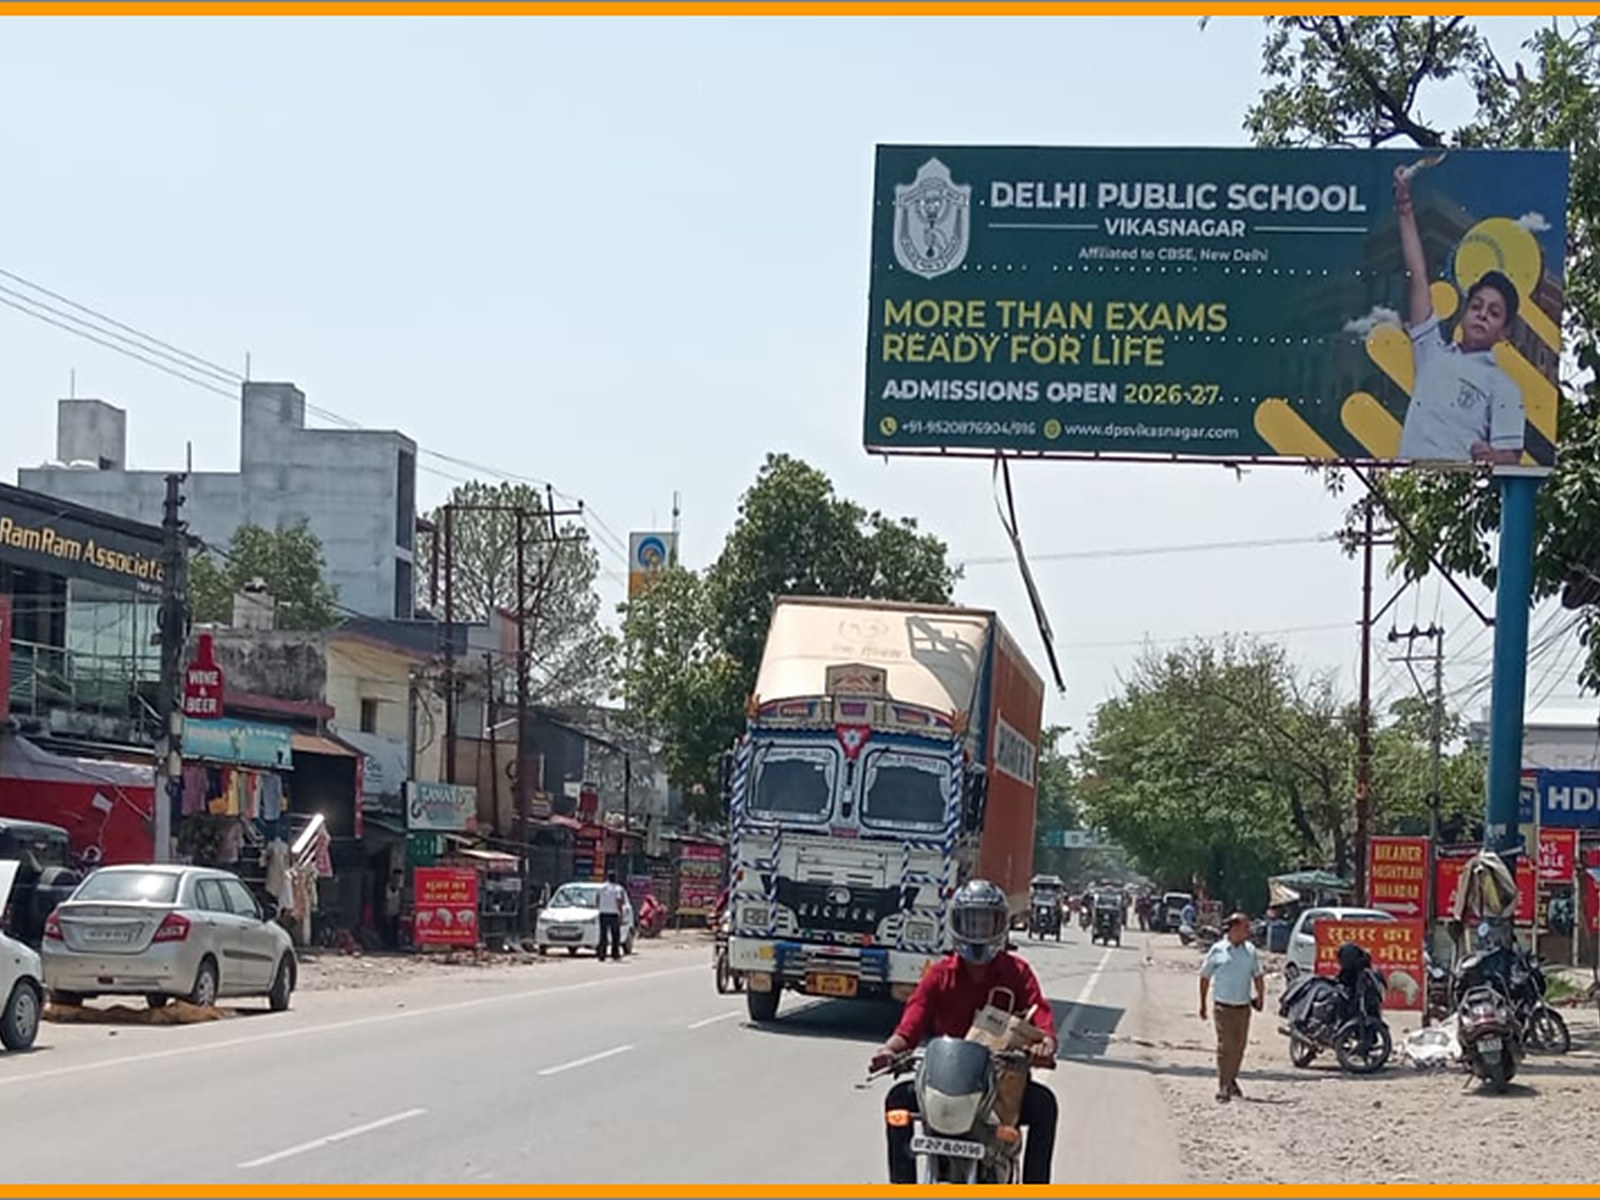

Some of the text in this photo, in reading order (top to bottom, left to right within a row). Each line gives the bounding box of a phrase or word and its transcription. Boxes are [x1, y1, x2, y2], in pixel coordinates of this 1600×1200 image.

[990, 181, 1087, 210] DELHI
[1098, 183, 1219, 212] PUBLIC
[1226, 184, 1367, 214] SCHOOL
[1104, 218, 1246, 238] VIKASNAGAR
[1078, 246, 1269, 263] Affiliated to CBSE, New Delhi
[883, 299, 1228, 333] MORE THAN EXAMS
[881, 334, 1165, 366] READY FOR LIFE
[881, 379, 1220, 406] ADMISSIONS OPEN 2026-27
[1064, 422, 1240, 442] www.dpsvikasnagar.com
[0, 517, 166, 582] RamRam Associate
[188, 670, 219, 687] WINE
[186, 696, 218, 714] BEER
